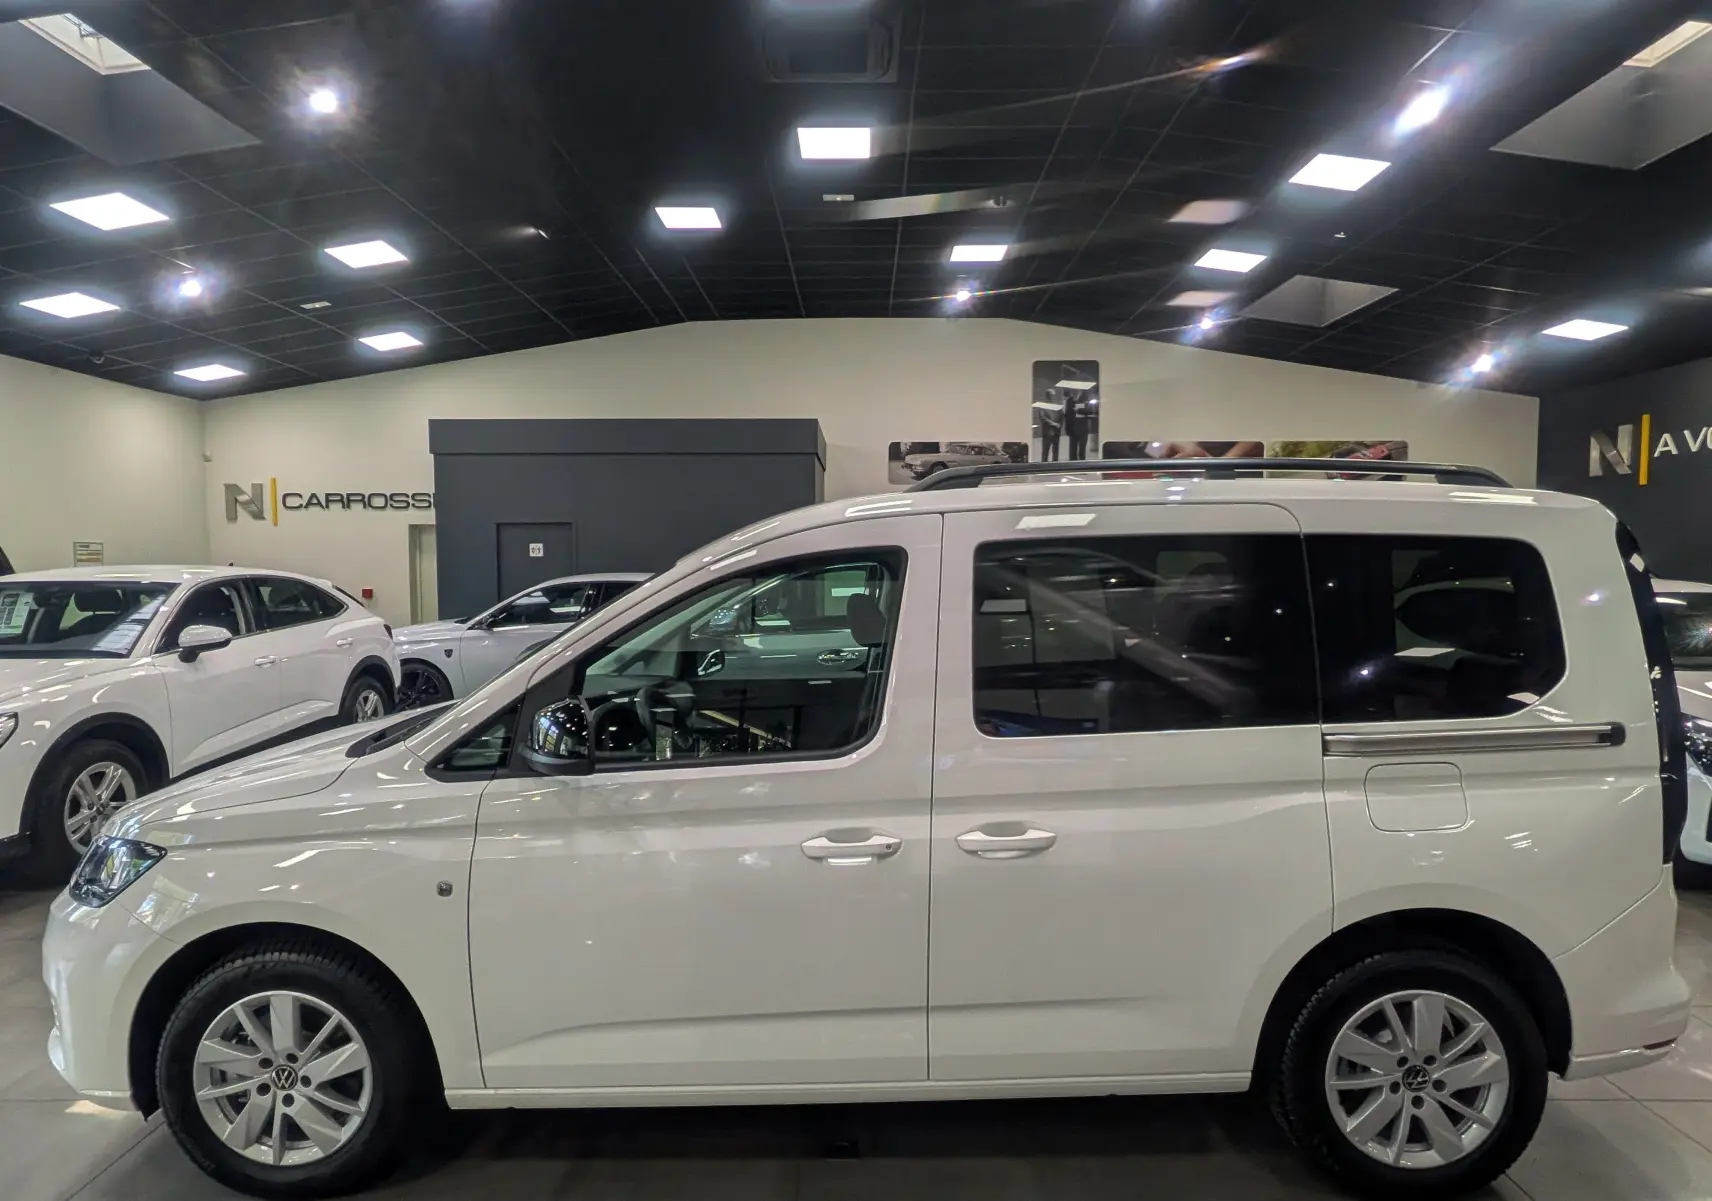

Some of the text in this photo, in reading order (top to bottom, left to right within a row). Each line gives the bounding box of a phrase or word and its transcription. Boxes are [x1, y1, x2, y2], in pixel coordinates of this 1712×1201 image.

[1653, 426, 1712, 457] A V
[281, 492, 435, 510] CARROSS
